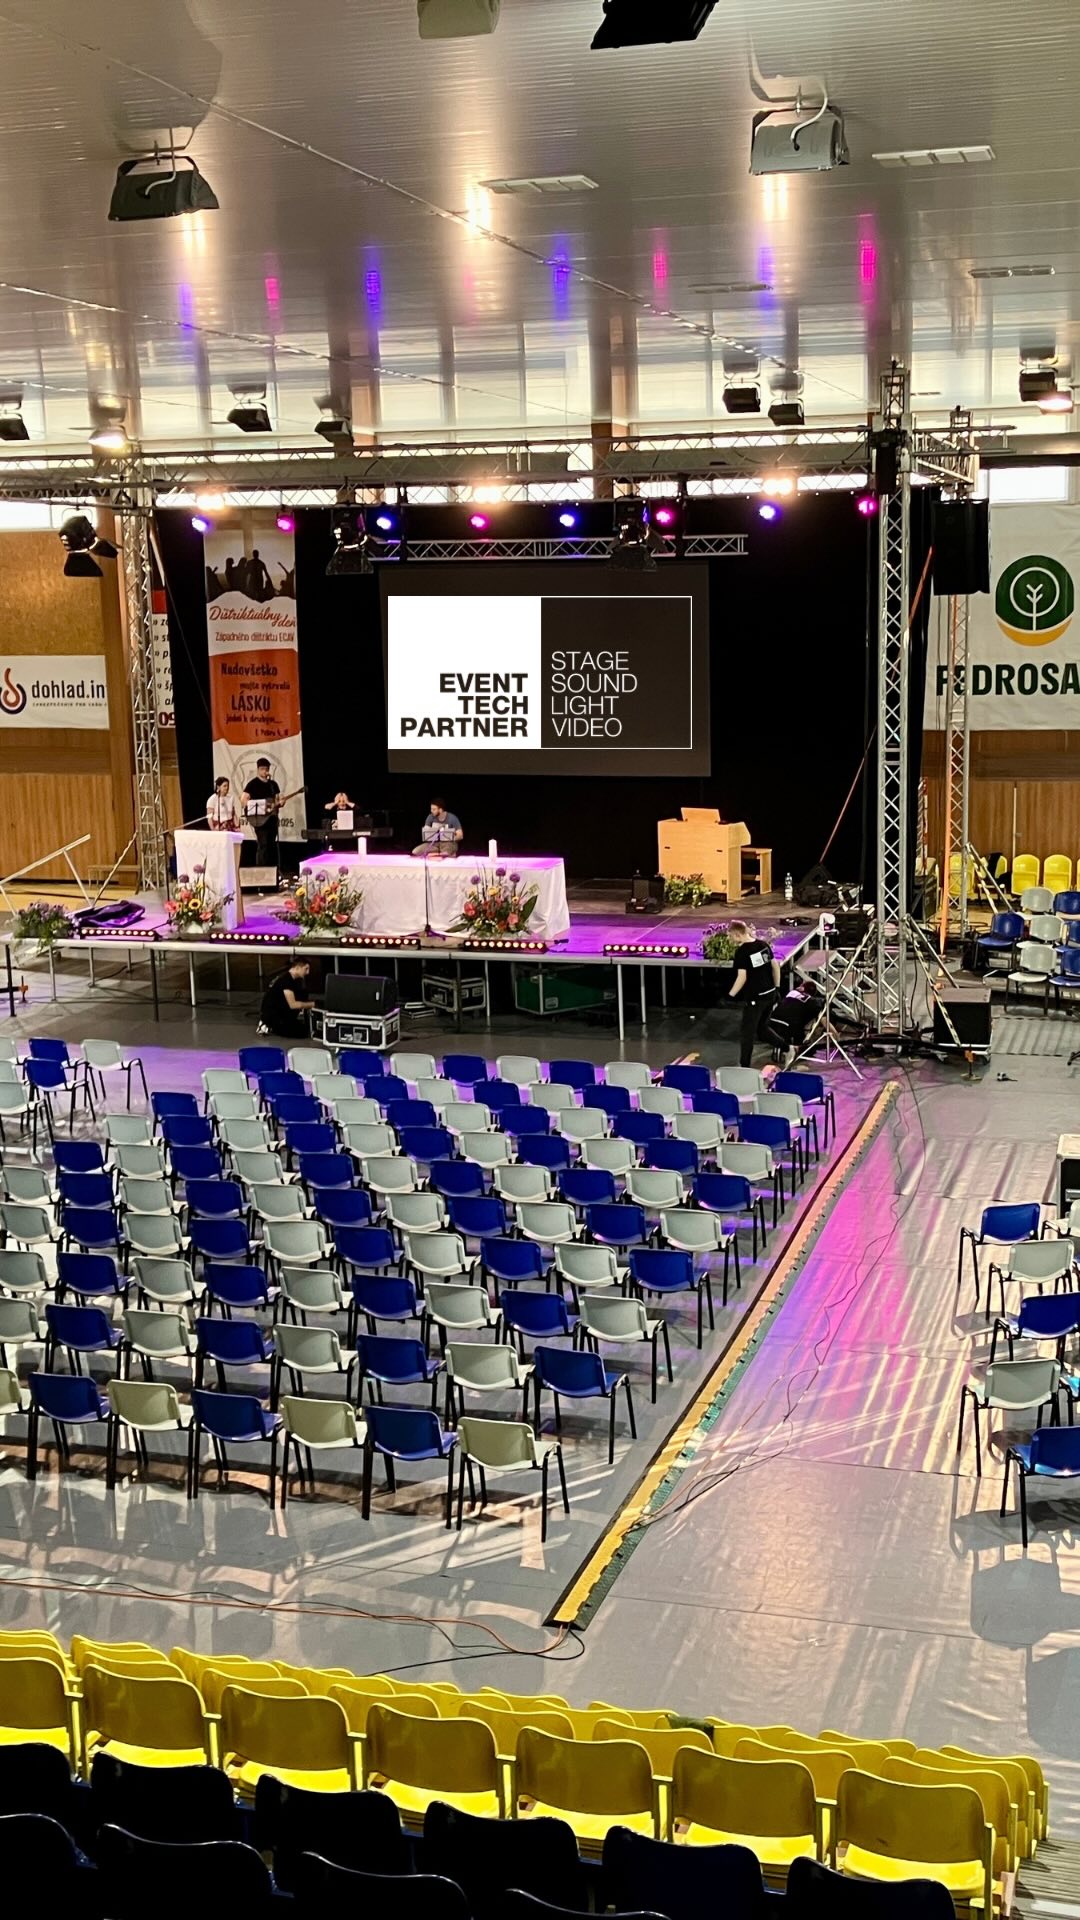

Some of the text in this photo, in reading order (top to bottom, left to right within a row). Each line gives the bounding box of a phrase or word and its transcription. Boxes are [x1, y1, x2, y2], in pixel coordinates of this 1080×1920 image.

[551, 651, 629, 671] STAGE
[31, 680, 106, 699] dohlad.in
[439, 673, 529, 693] EVENT
[551, 673, 638, 693] SOUND
[231, 691, 271, 711] LÁSKU
[457, 695, 529, 715] TECH
[551, 695, 620, 715] LIGHT
[400, 717, 529, 737] PARTNER
[551, 717, 623, 737] VIDEO
